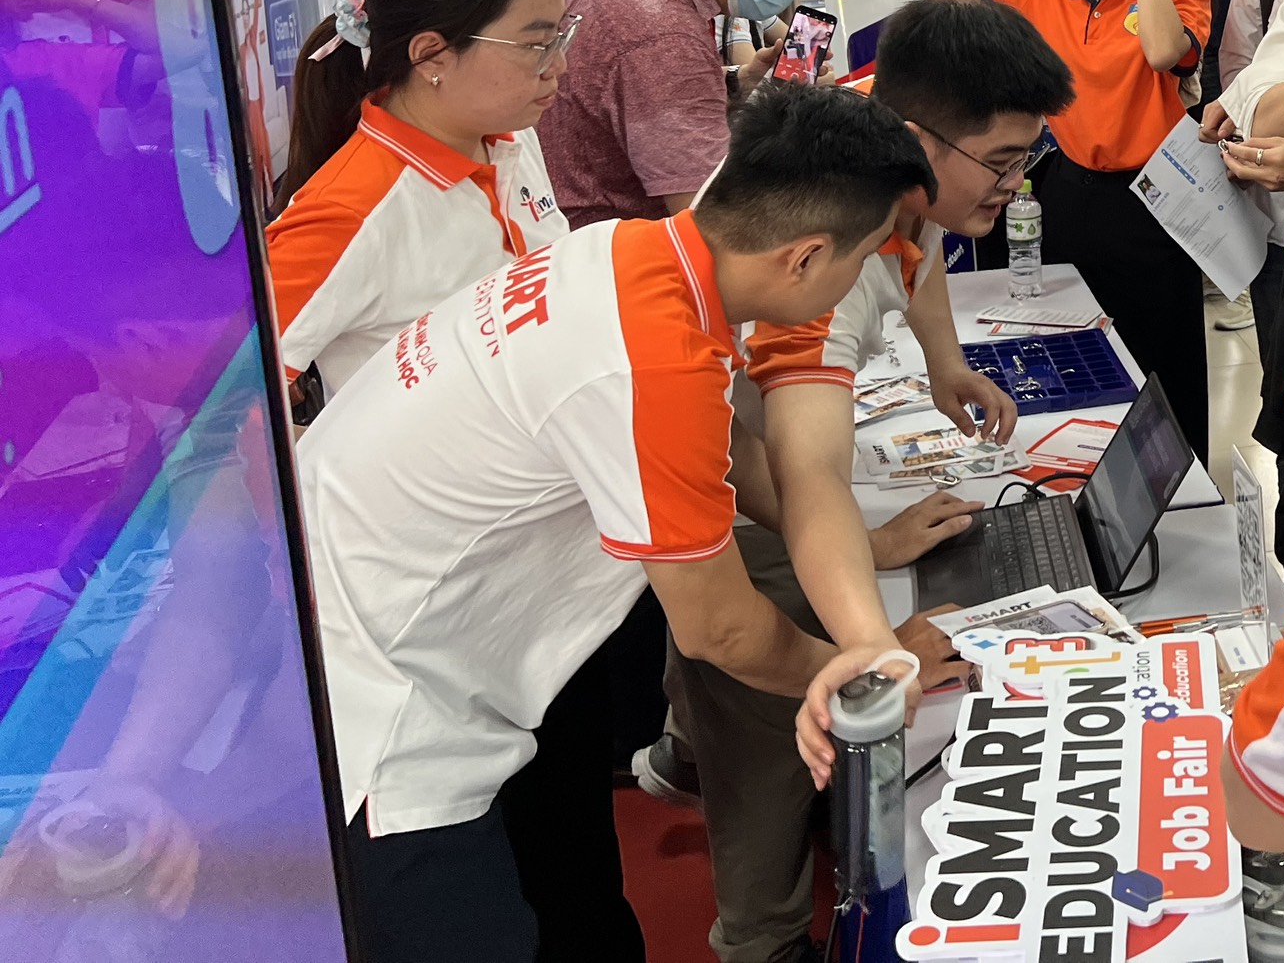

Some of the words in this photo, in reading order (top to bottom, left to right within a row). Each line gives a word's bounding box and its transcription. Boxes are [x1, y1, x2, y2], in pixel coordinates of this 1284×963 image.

[505, 244, 553, 335] MART
[397, 357, 420, 390] HỌC
[1133, 651, 1151, 682] ation
[1157, 735, 1210, 797] Fair
[908, 697, 1049, 947] iSMART
[1038, 676, 1127, 963] EDUCATION
[1160, 805, 1212, 872] Job
